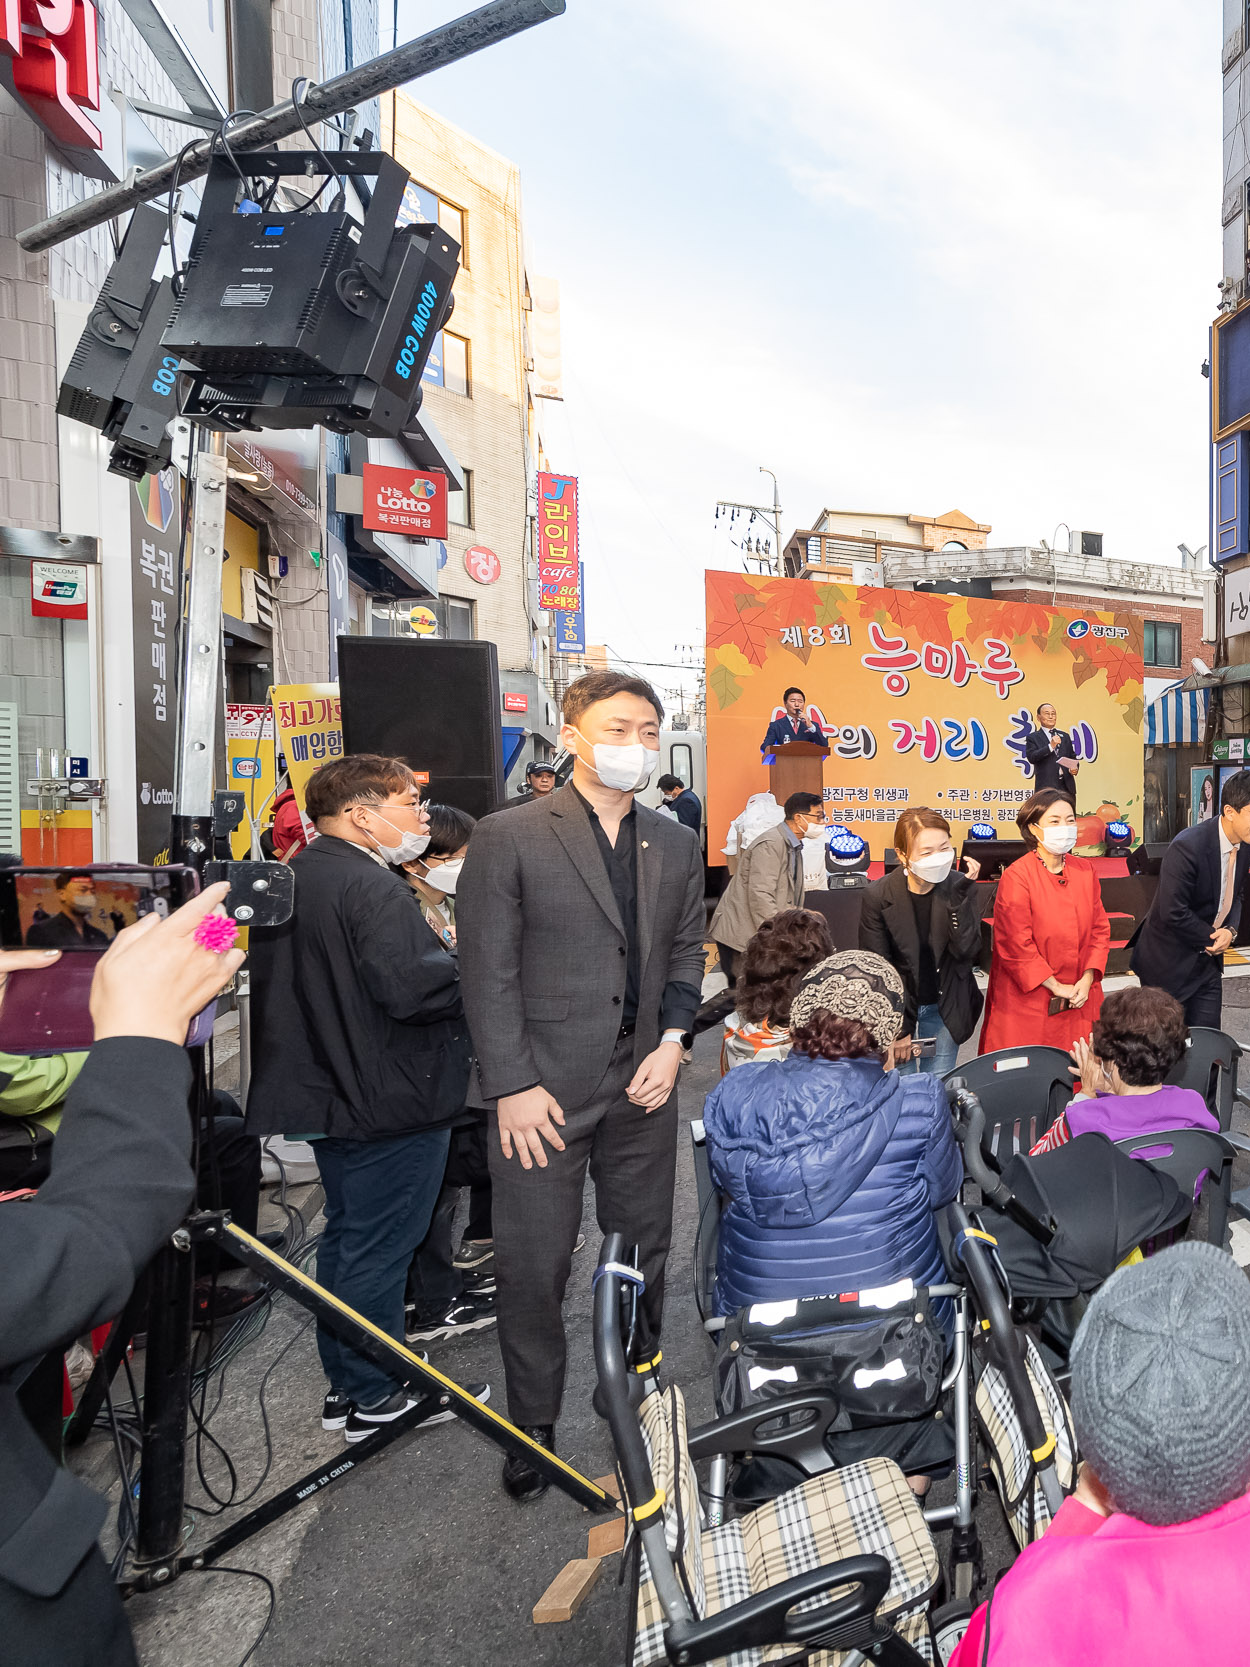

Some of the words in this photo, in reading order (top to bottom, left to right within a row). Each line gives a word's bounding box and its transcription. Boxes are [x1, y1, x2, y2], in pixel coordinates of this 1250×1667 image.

[410, 280, 438, 338] 400W
[395, 336, 421, 380] COB
[152, 356, 180, 397] COB
[380, 486, 403, 497] 나눔
[544, 478, 573, 500] J
[377, 493, 431, 513] Lotto
[377, 512, 431, 528] 복권판매점
[543, 501, 573, 565] 라이브
[40, 566, 79, 575] WELCOME
[542, 565, 576, 582] cafe
[542, 583, 559, 595] 70
[559, 584, 577, 596] 80
[542, 594, 578, 609] 노래장
[780, 622, 852, 649] 제8회
[1090, 624, 1129, 640] 광진구
[862, 621, 1024, 699] 능마루
[888, 716, 989, 762] 거리
[152, 788, 174, 804] Lotto
[822, 788, 869, 802] 광진구청
[873, 788, 909, 802] 위생과
[947, 789, 970, 802] 주관
[981, 789, 1035, 802] 상가번영회
[296, 1483, 318, 1499] MADE
[318, 1474, 330, 1486] IN
[330, 1460, 355, 1478] CHINA
